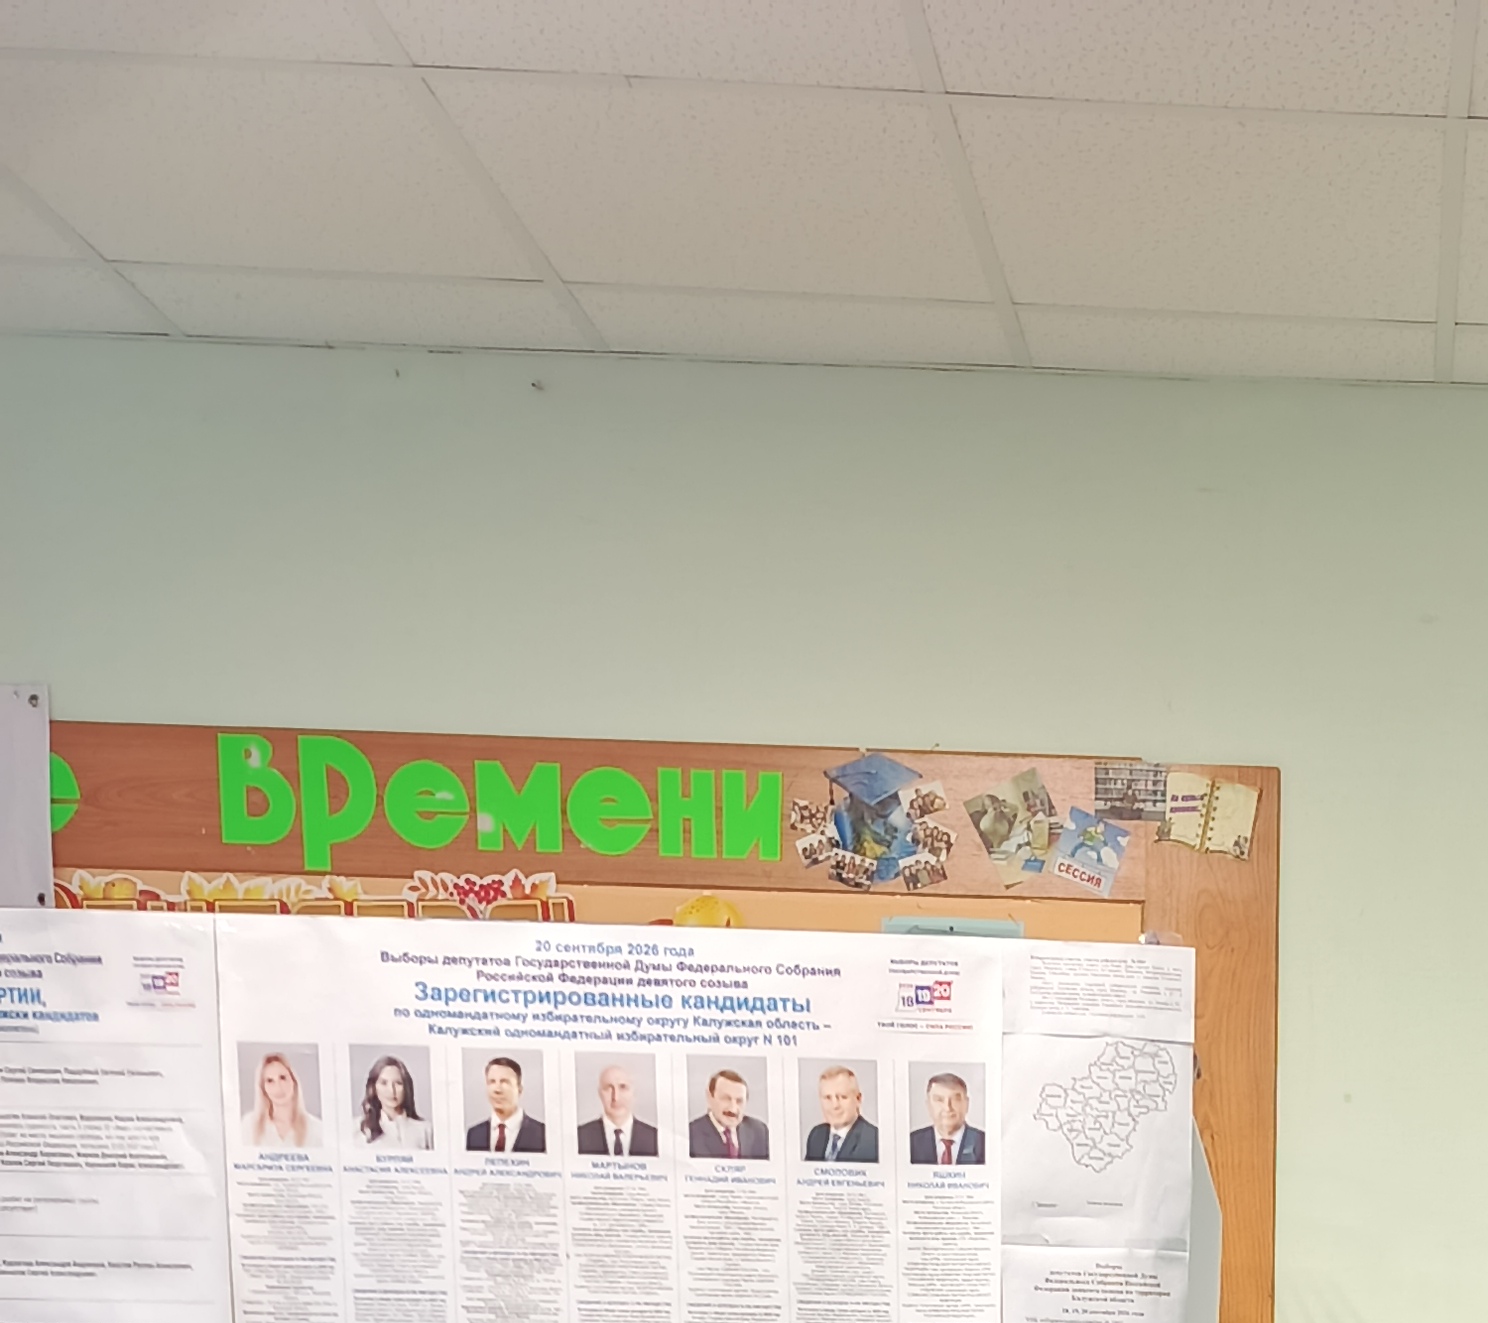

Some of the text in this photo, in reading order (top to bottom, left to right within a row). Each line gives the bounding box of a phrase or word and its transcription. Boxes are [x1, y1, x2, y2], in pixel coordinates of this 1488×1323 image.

[1057, 862, 1103, 888] СЕССИЯ
[556, 942, 622, 955] сентября
[627, 944, 659, 955] 2026
[663, 946, 695, 958] года
[381, 951, 841, 978] Выборы депутатов Государственной Думы Федерального Собрания
[476, 970, 749, 989] Российской Федерации девятого созыва
[414, 982, 812, 1014] Зарегистрированные кандидаты
[414, 1008, 528, 1023] одномандатному
[532, 1011, 643, 1026] избирательному
[646, 1017, 689, 1029] округу
[693, 1016, 763, 1030] Калужская
[767, 1018, 820, 1031] область
[428, 1023, 500, 1037] Калужский
[504, 1027, 612, 1041] одномандатный
[616, 1031, 720, 1045] избирательный
[724, 1034, 759, 1047] округ
[776, 1035, 798, 1046] 101
